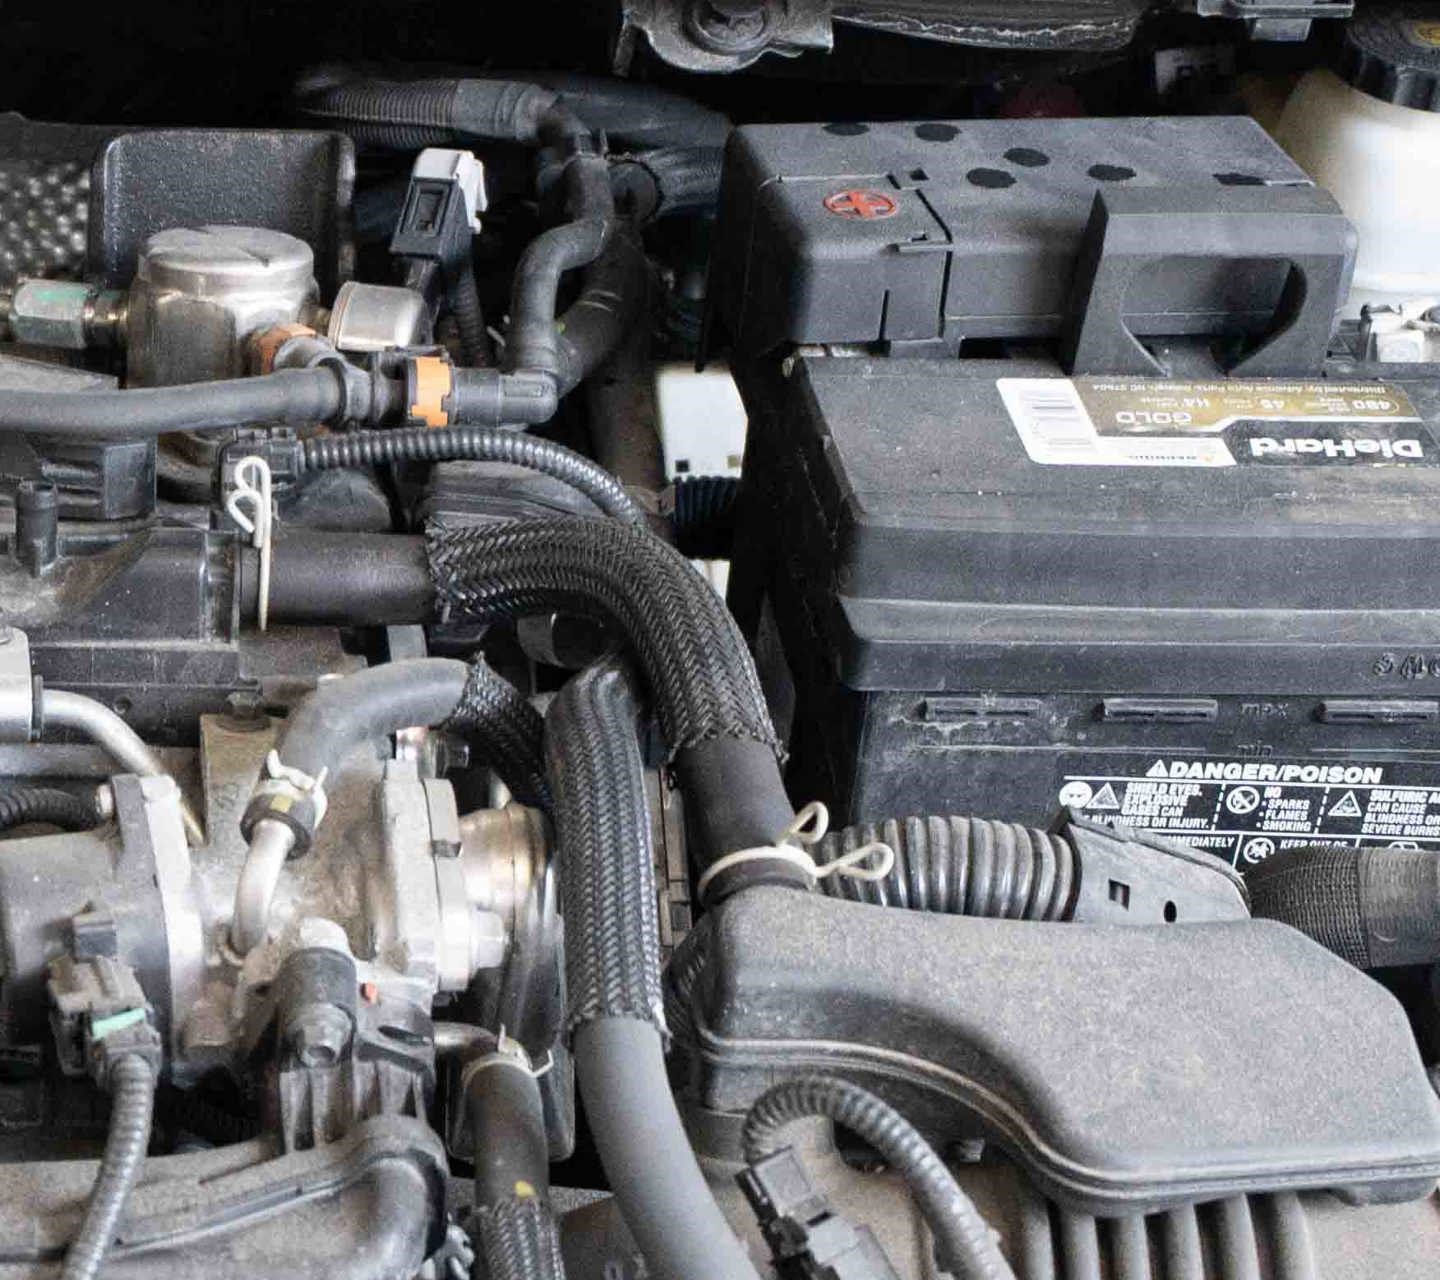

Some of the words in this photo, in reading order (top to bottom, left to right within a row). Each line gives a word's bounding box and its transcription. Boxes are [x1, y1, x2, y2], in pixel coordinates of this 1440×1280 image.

[1115, 410, 1193, 426] GOLD
[1248, 436, 1426, 458] DieHard
[1169, 761, 1384, 785] DANGER/POISON
[1126, 782, 1168, 795] SHIELD
[1123, 792, 1189, 807] EXPLOSIVE
[1369, 789, 1429, 804] SULFURIC
[1121, 805, 1160, 816] GASES
[1161, 806, 1184, 817] CAN
[1267, 799, 1311, 810] SPARKS
[1366, 802, 1390, 814] CAN
[1390, 803, 1428, 816] CAUSE
[1264, 809, 1308, 821] FLAMES
[1363, 813, 1424, 826] BLINDNESS
[1151, 816, 1168, 827] OR
[1168, 817, 1210, 829] INJURY.
[1262, 820, 1312, 832] SMOKING
[1360, 824, 1403, 836] SEVERE
